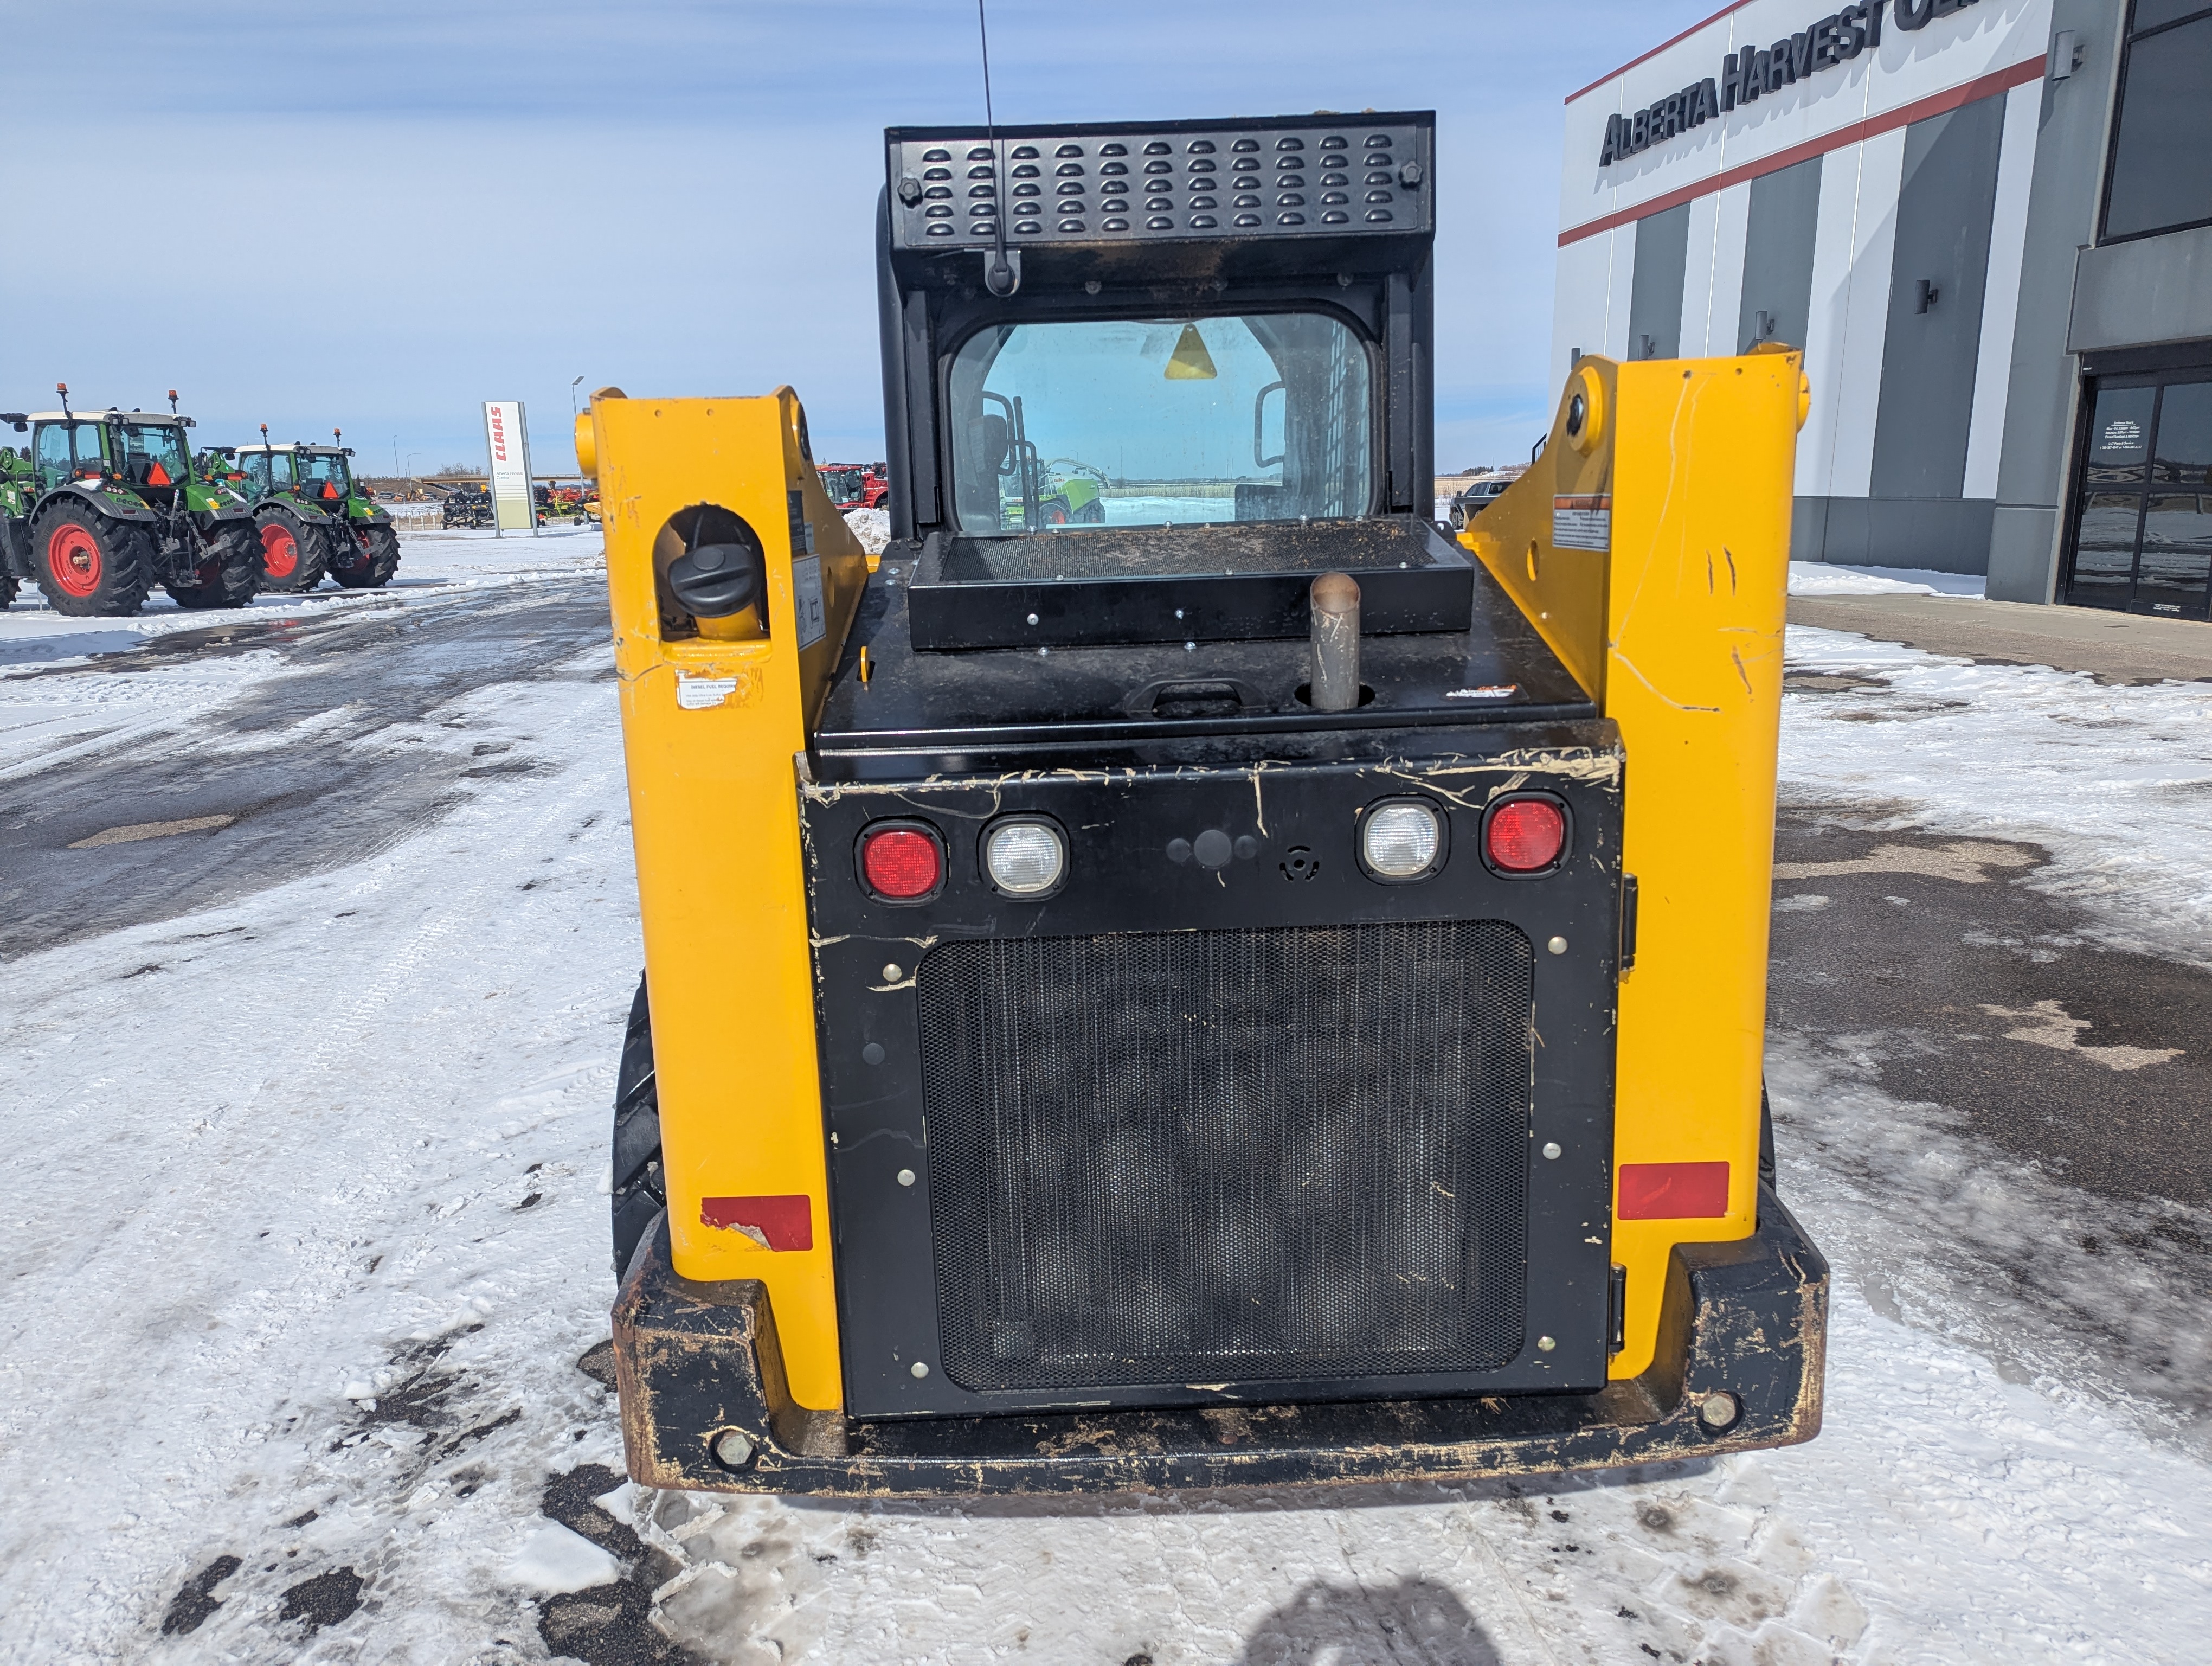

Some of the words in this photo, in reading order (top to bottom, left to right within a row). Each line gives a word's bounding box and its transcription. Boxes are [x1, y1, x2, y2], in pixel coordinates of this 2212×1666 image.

[1599, 78, 1719, 167] ALBERTA
[1720, 0, 1895, 112] HARVEST
[490, 406, 506, 461] CLAAS
